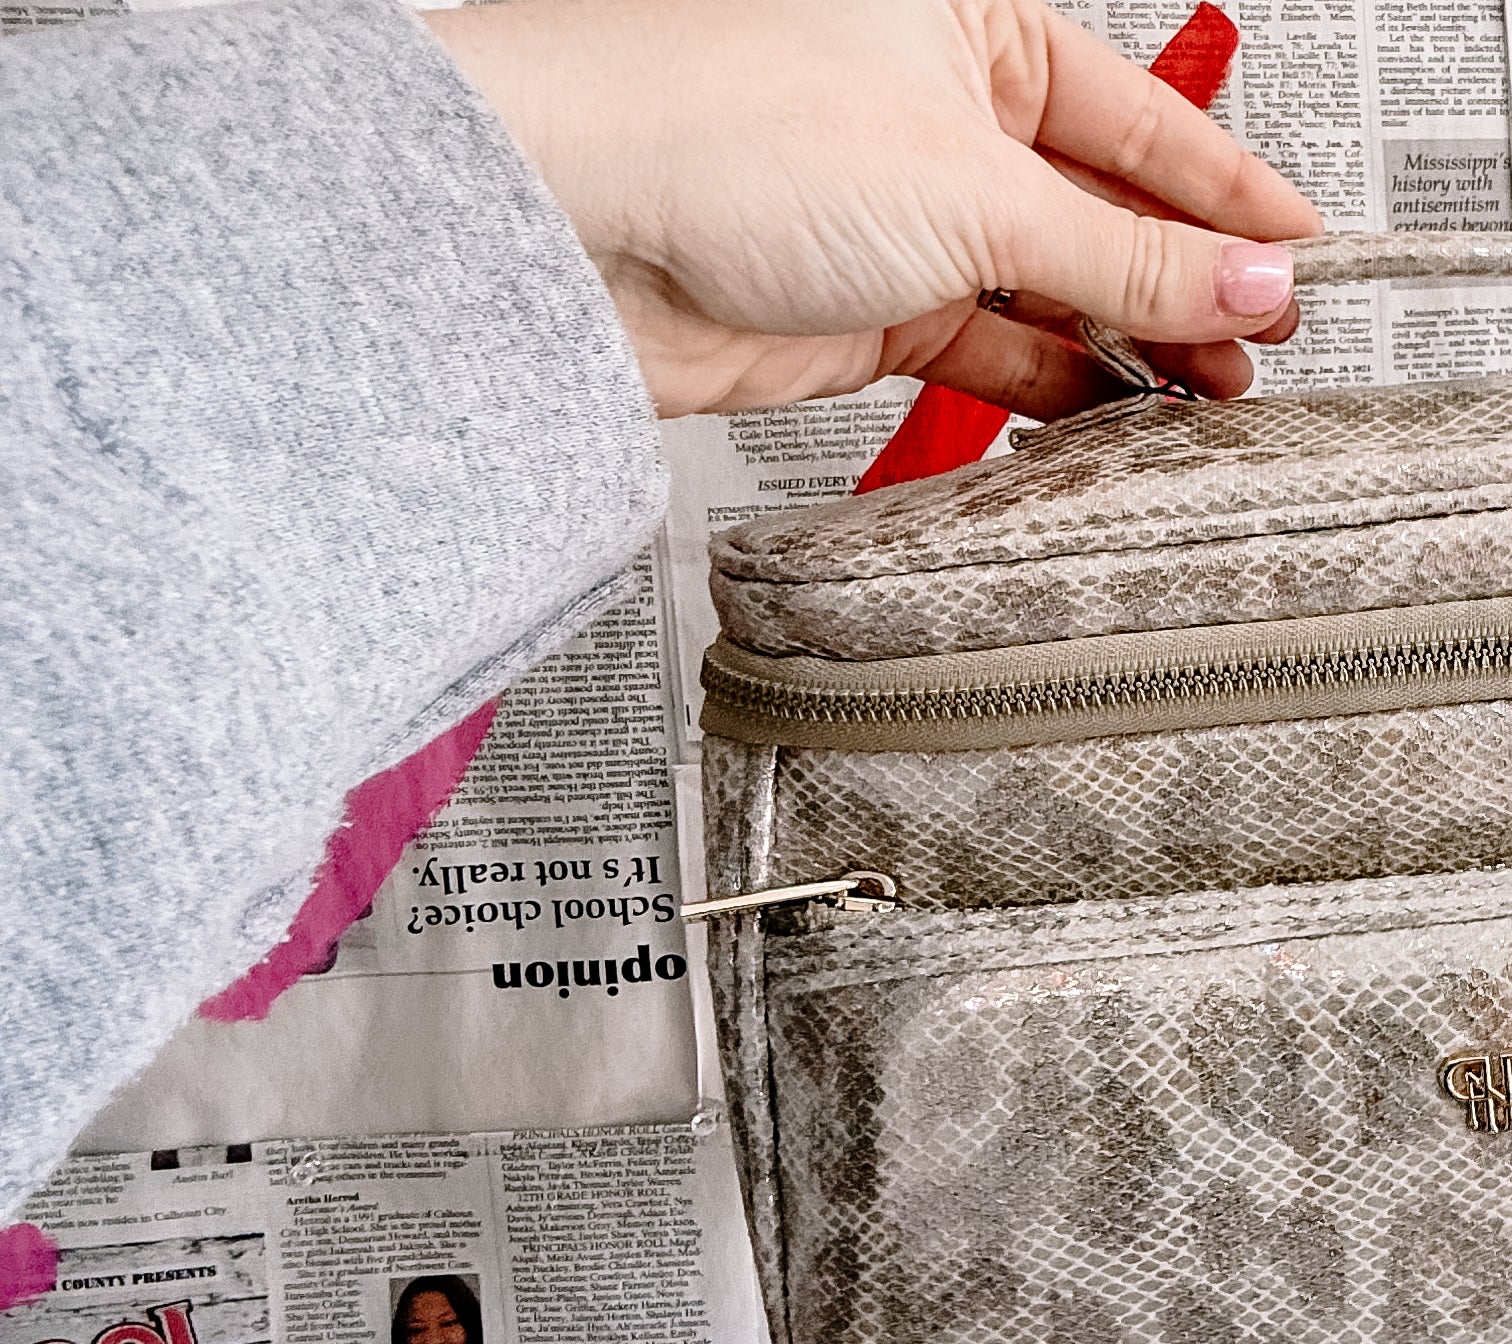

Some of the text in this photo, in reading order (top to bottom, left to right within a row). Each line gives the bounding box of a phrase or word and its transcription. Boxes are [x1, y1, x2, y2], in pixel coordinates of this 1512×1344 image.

[412, 855, 670, 895] It's not really.
[407, 888, 686, 934] School choice?
[492, 941, 689, 998] opinion
[61, 1264, 216, 1291] COUNTY PRESENTS
